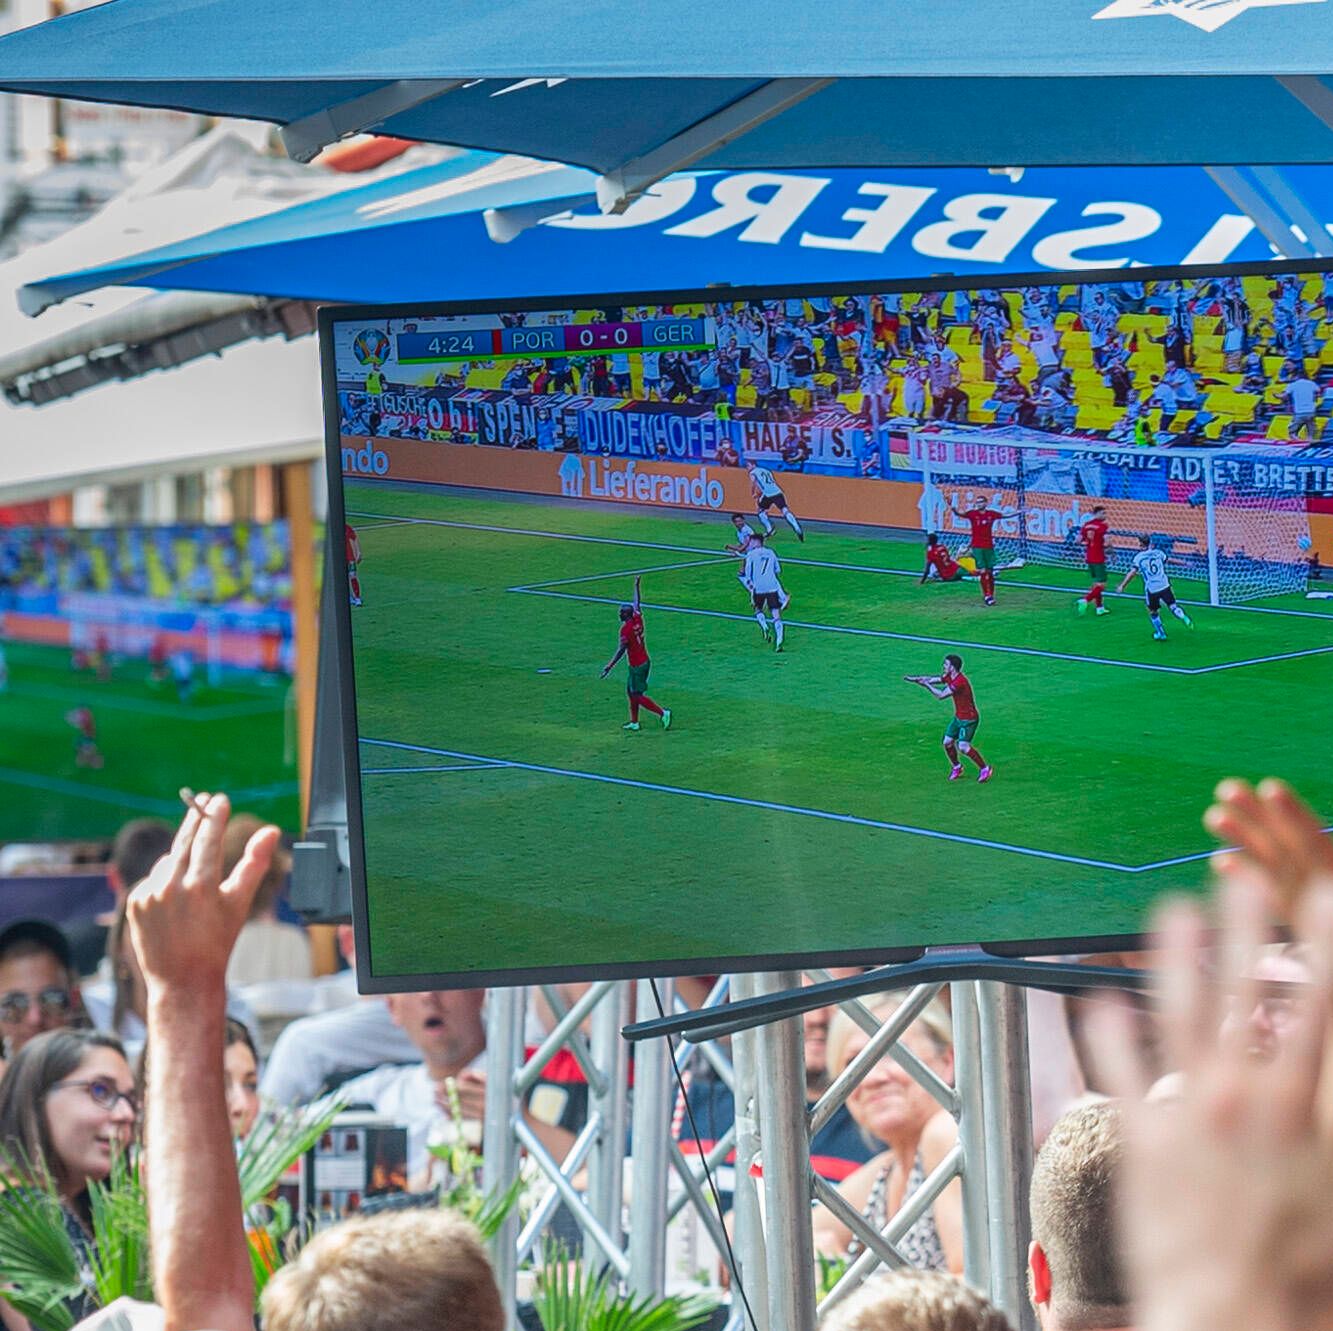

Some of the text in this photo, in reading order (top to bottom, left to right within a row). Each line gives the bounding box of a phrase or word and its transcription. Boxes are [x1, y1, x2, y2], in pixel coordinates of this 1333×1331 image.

[428, 334, 474, 354] 4:24
[511, 331, 555, 350] POR
[653, 325, 694, 343] GER
[590, 458, 725, 509] Lieferando
[759, 556, 770, 577] 7
[1149, 557, 1160, 577] 6
